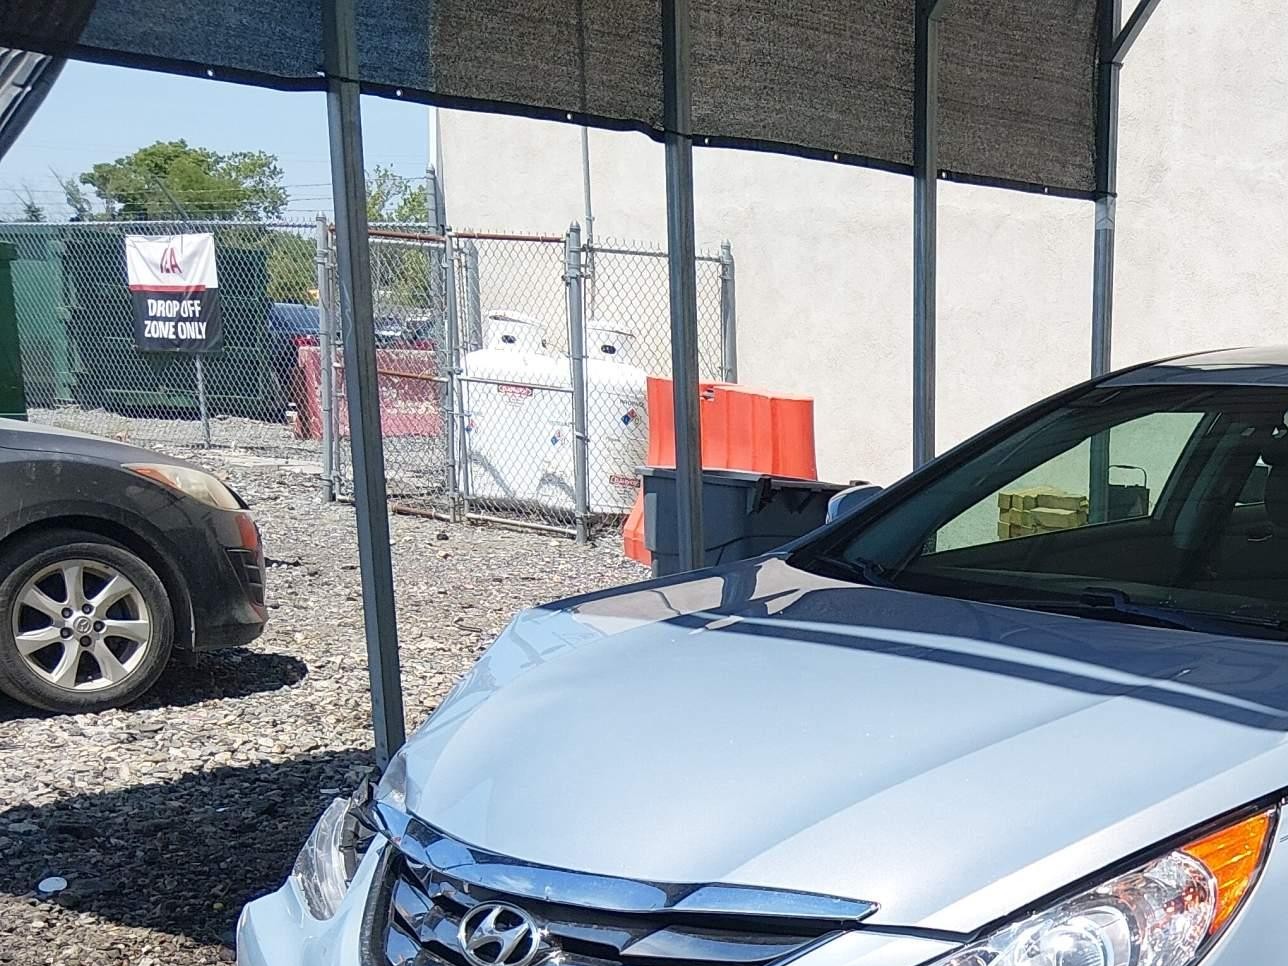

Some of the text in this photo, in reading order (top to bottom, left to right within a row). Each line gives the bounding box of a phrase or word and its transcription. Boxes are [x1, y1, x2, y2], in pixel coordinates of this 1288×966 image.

[147, 299, 202, 318] DROP OFF
[144, 320, 207, 340] ZONE ONLY
